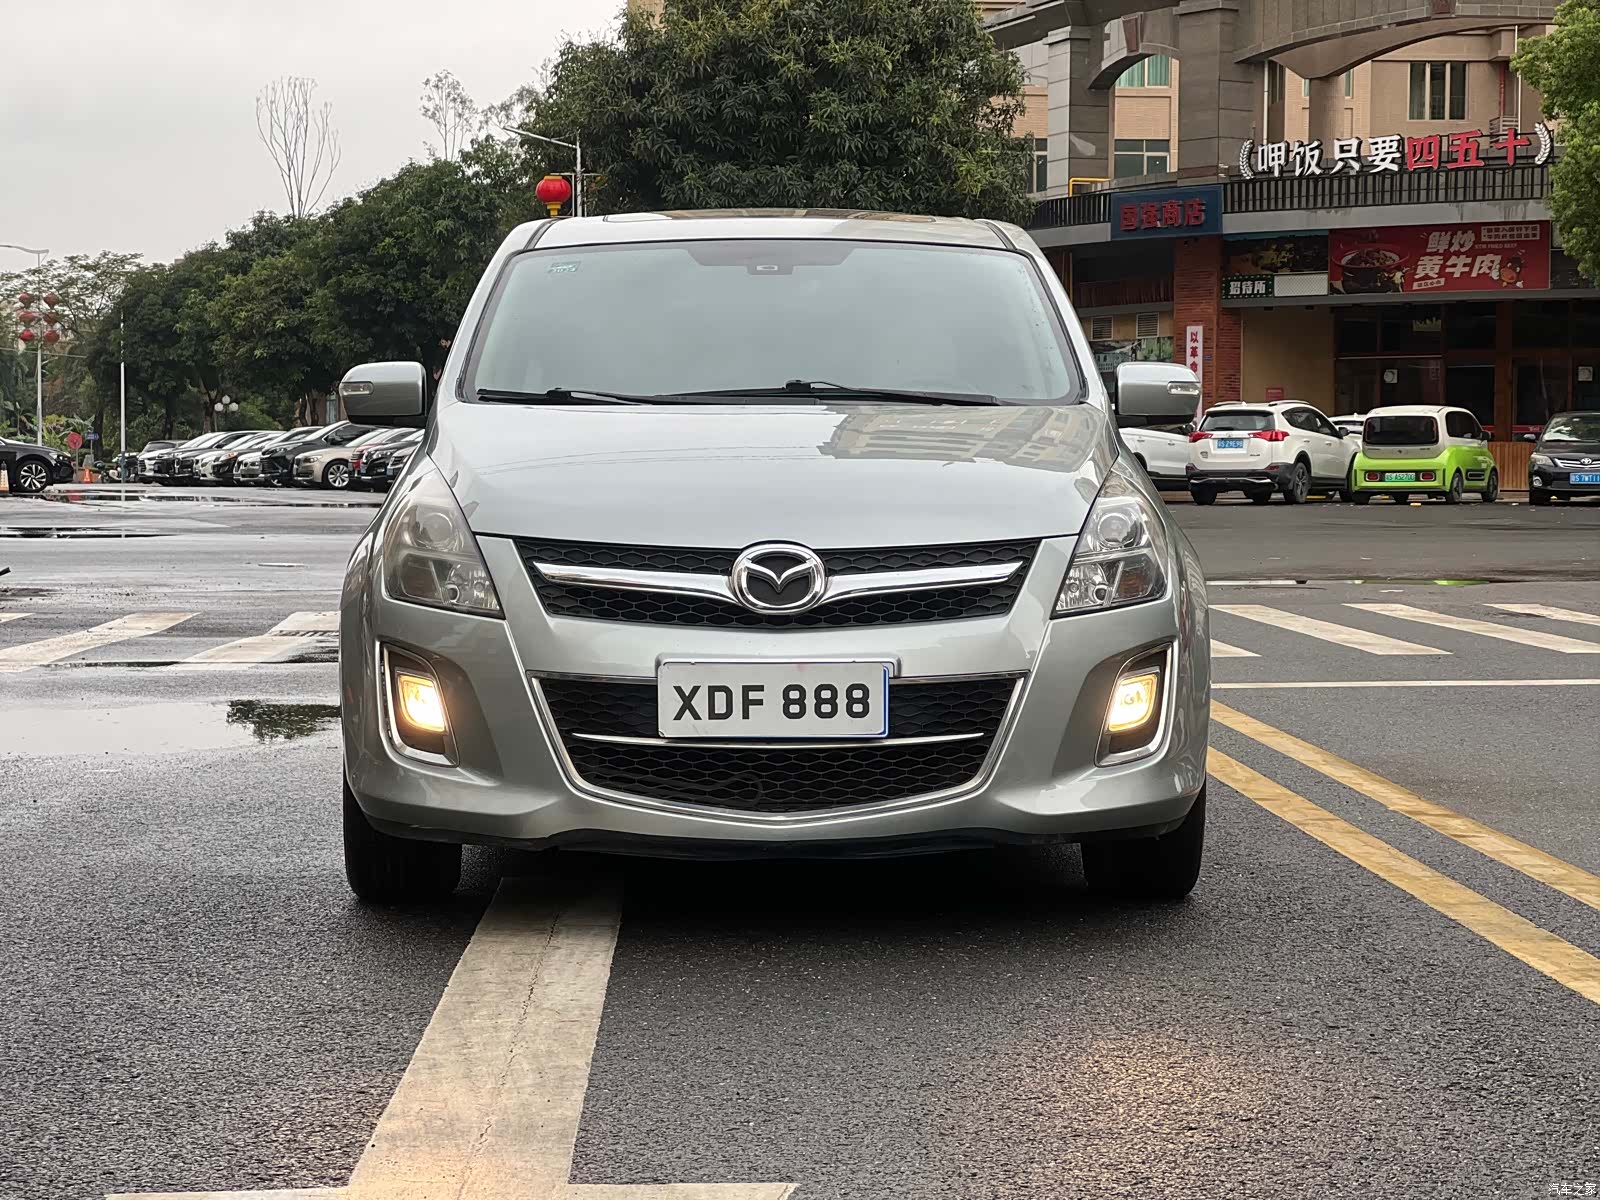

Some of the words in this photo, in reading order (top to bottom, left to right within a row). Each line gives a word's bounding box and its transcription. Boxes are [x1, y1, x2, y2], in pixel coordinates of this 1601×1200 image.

[1257, 128, 1530, 177] 呷饭只要四五十
[1426, 230, 1476, 253] 鲜炒
[1414, 254, 1502, 278] 黄牛肉
[1229, 281, 1266, 294] 招待所
[673, 684, 765, 721] XDF
[782, 683, 870, 719] 888
